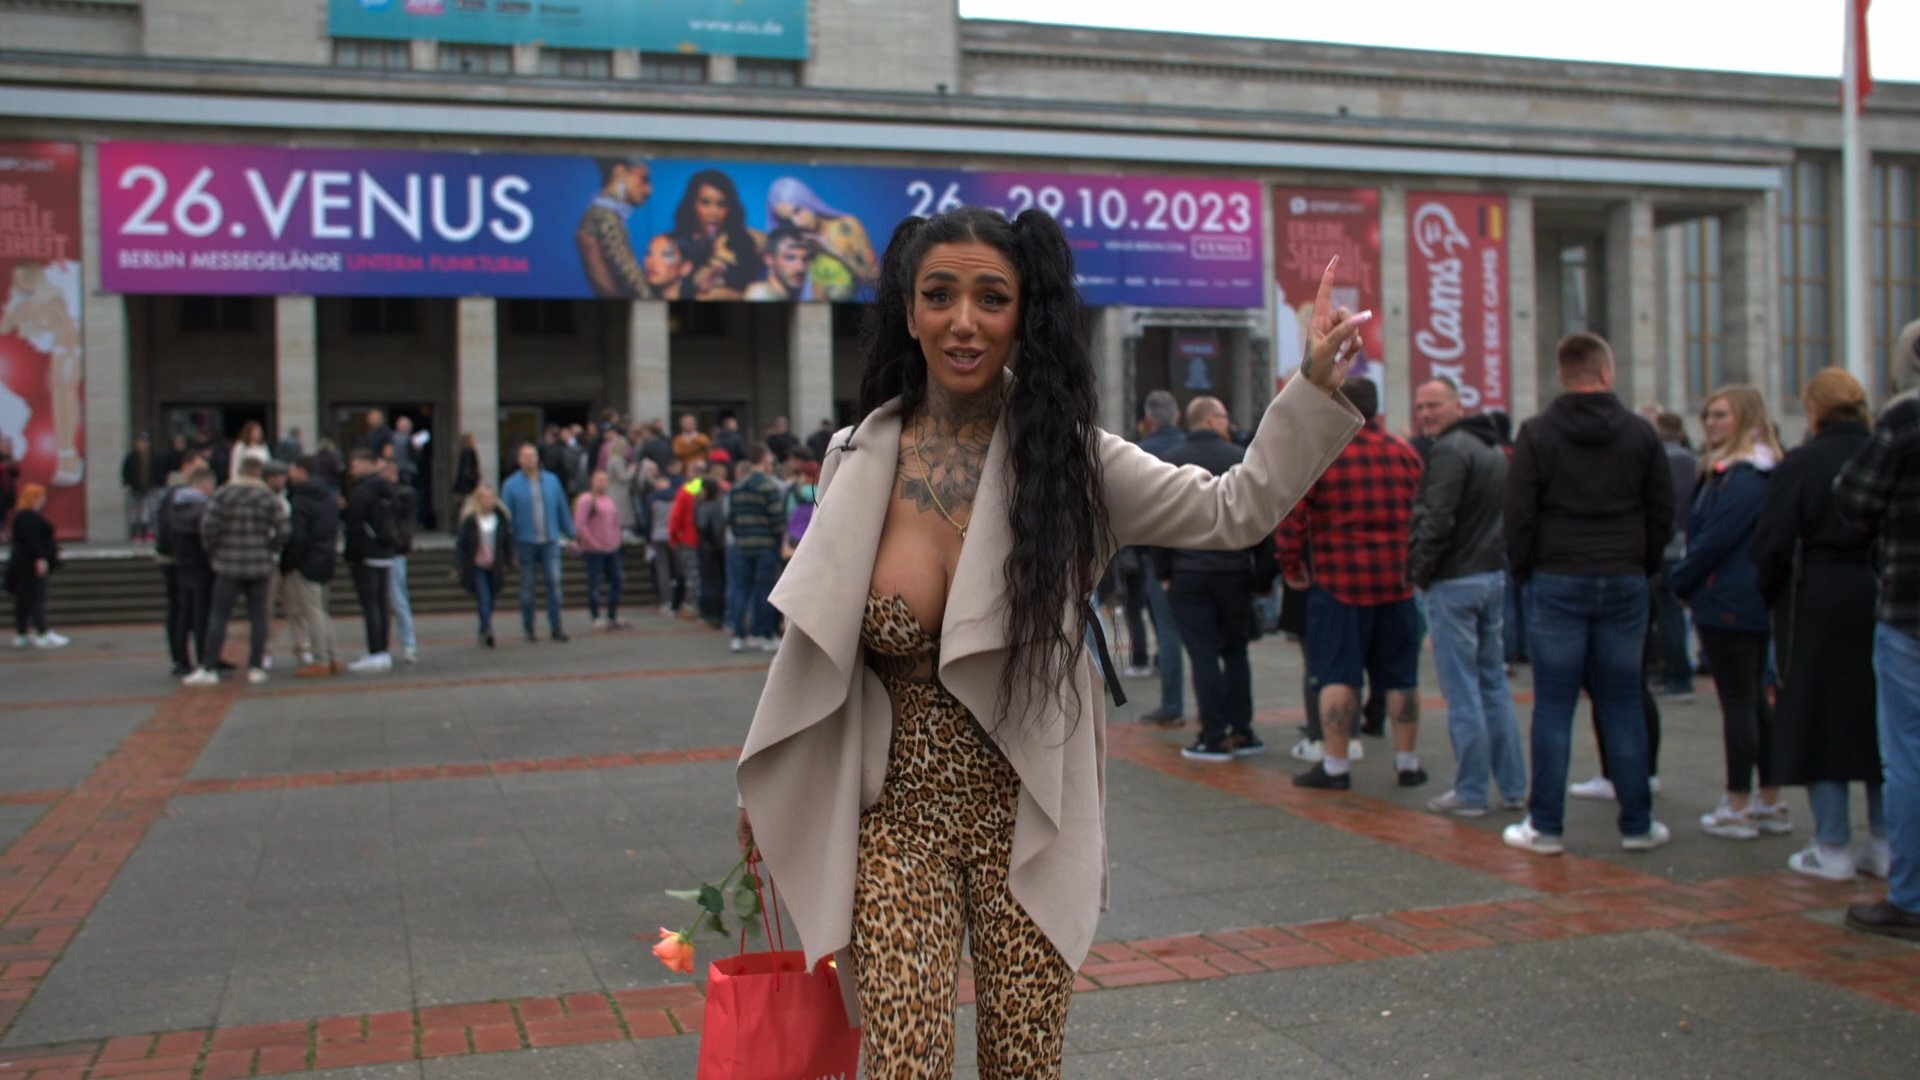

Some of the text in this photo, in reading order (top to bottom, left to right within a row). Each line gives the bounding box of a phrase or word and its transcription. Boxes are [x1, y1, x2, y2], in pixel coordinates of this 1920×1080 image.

[119, 164, 534, 244] 26.VENUS
[119, 250, 529, 273] BERLIN MESSEGELÄNDE UNTERM FUNKTURM
[1482, 249, 1498, 308] CAMS
[1483, 312, 1499, 349] SEX
[1484, 354, 1502, 399] LIVE
